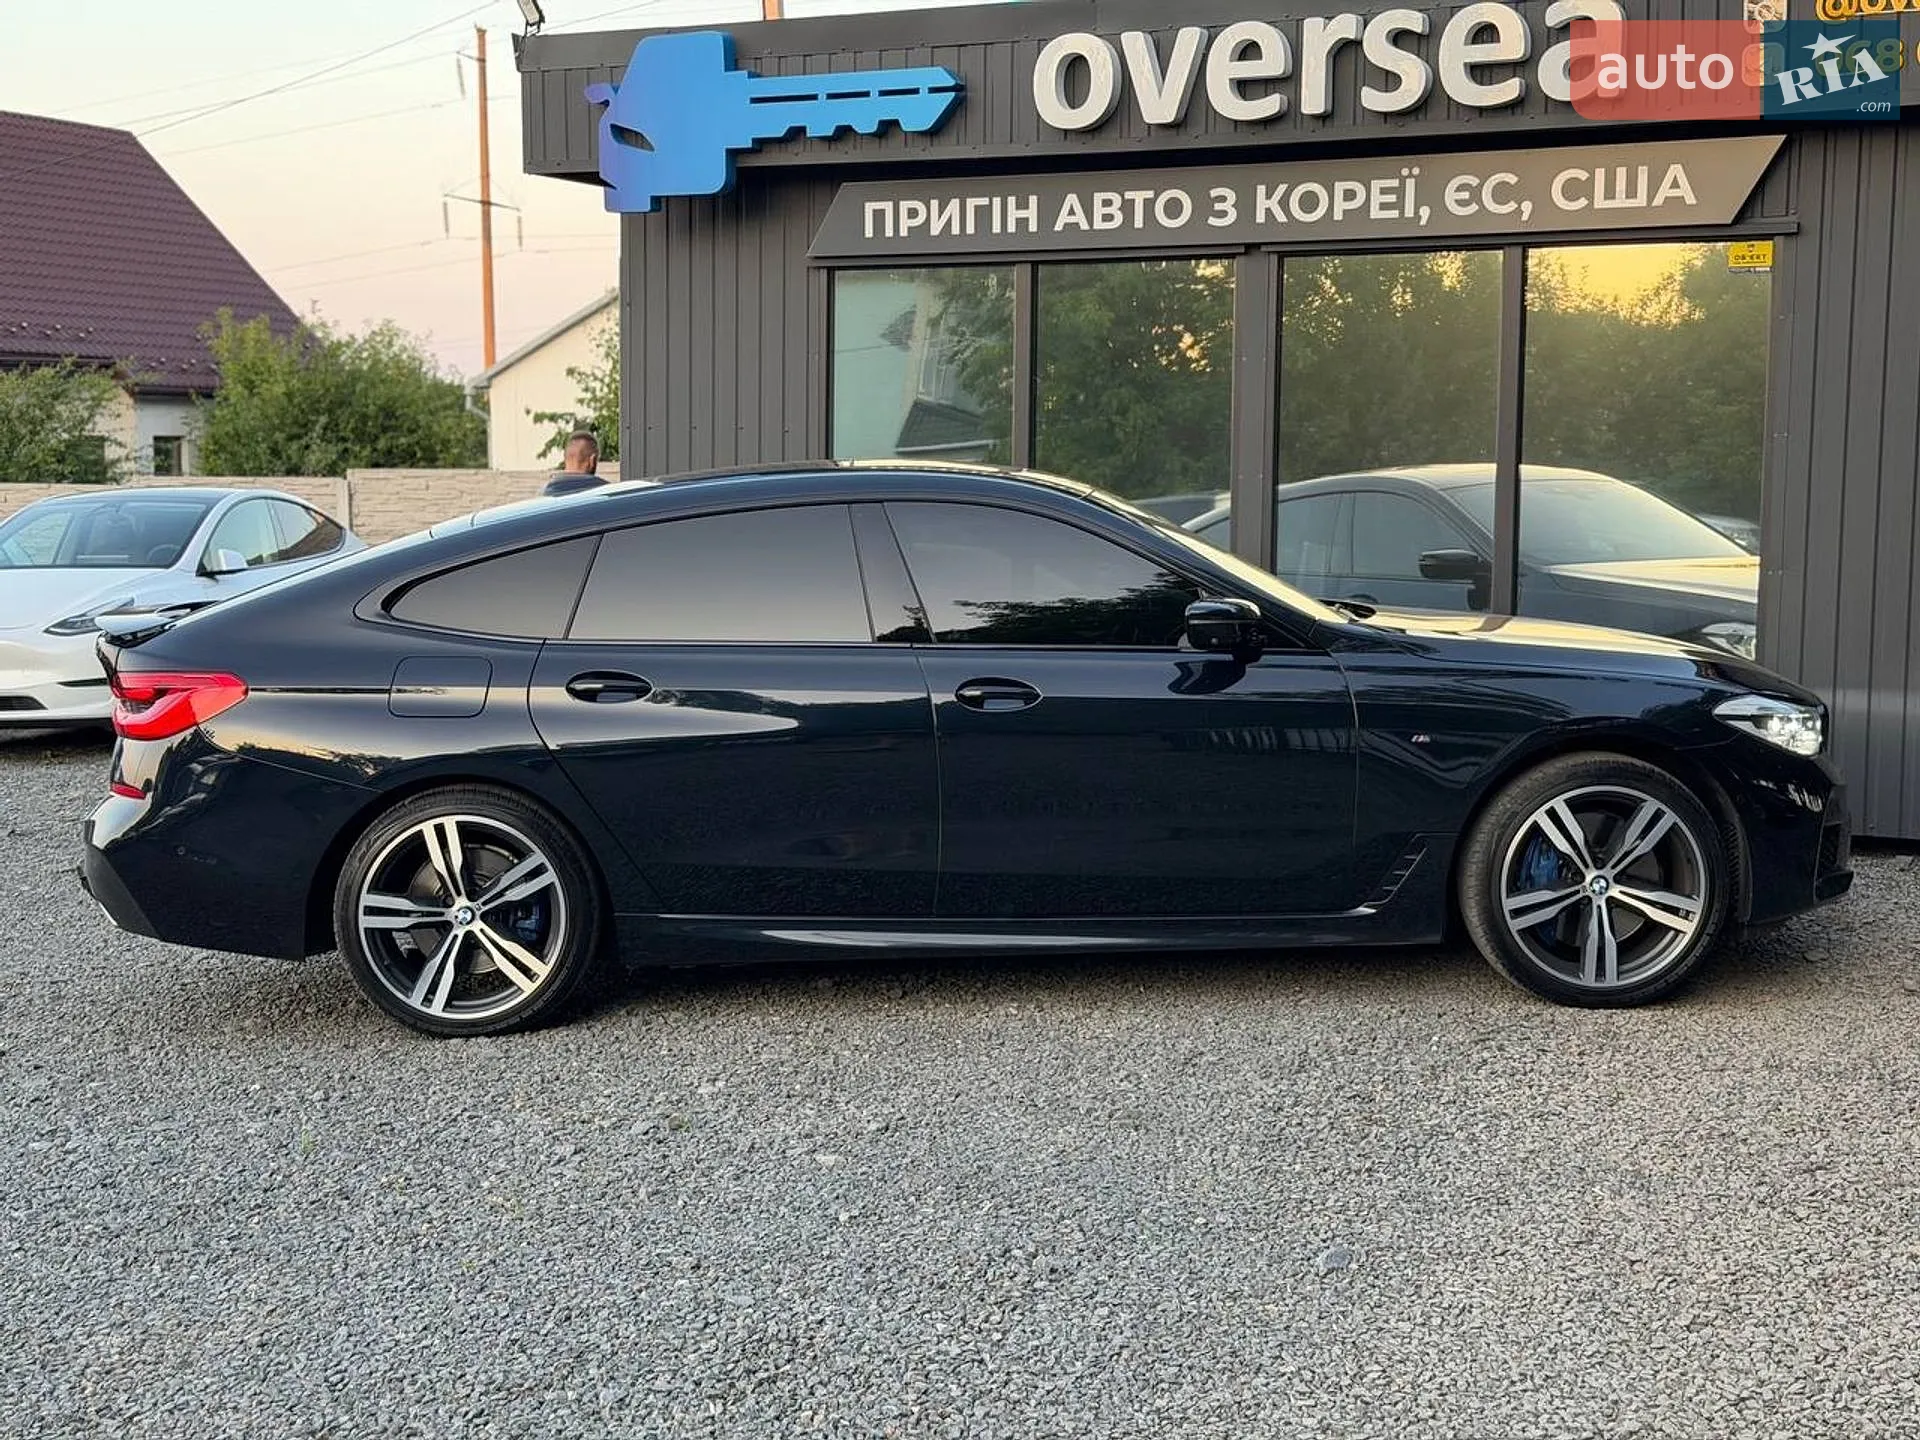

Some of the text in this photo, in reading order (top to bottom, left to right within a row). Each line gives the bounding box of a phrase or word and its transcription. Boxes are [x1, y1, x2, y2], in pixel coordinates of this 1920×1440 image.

[1033, 0, 1626, 131] oversea
[863, 163, 1698, 239] ПРИГІН АВТО З КОРЕЇ, ЄС, США
